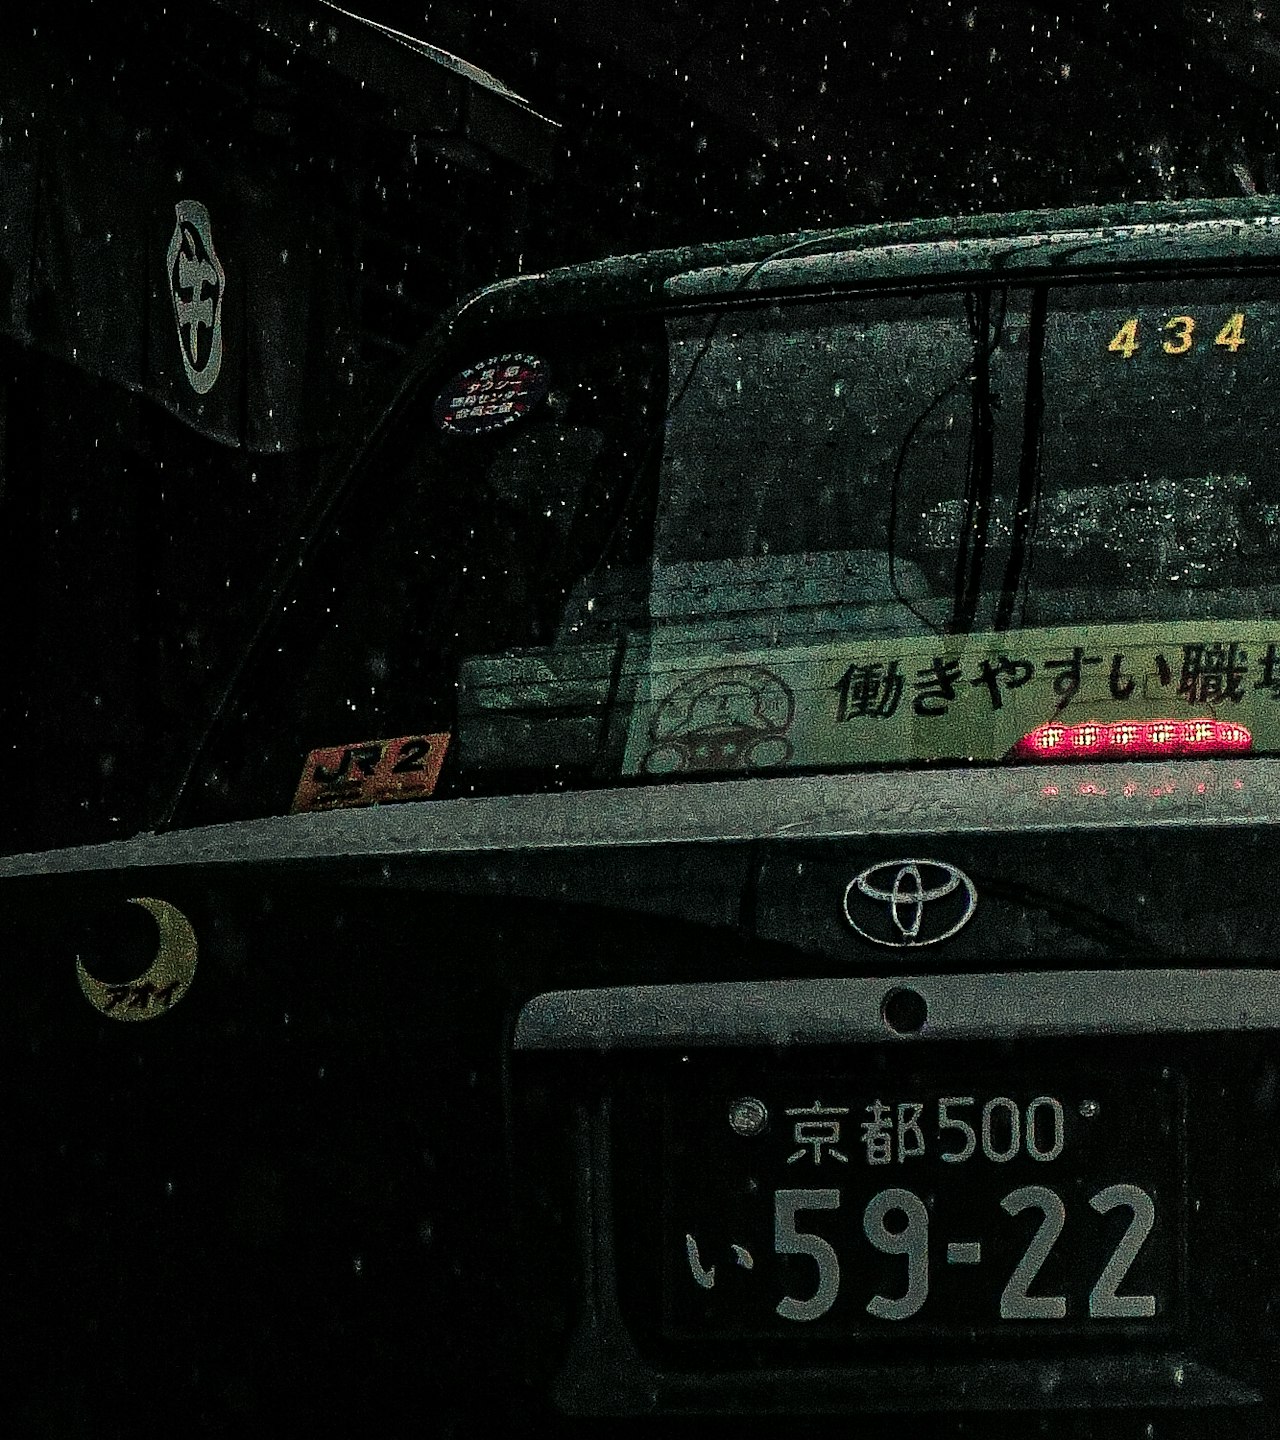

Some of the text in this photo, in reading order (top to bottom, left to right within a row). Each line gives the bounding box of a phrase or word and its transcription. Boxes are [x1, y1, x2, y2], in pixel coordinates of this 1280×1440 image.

[104, 979, 181, 1012] アオイ
[685, 1183, 1157, 1321] い 59-22
